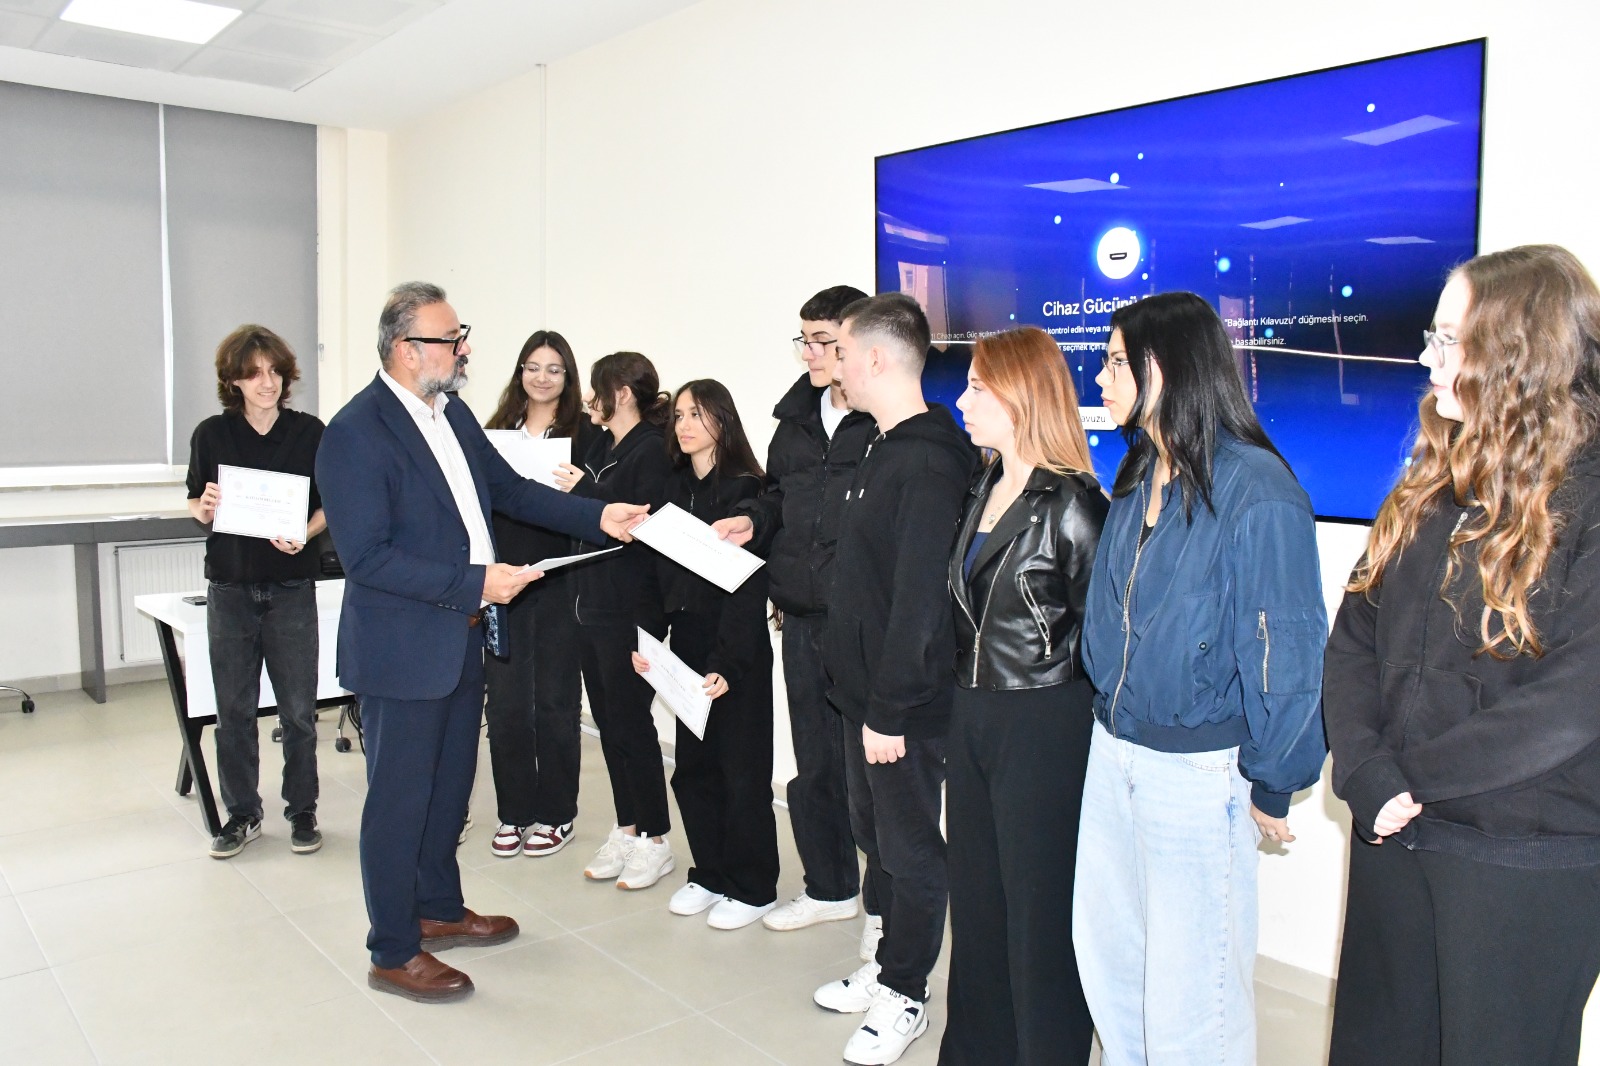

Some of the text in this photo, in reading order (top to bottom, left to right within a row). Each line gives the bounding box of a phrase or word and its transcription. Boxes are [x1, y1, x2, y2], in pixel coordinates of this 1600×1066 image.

[1042, 300, 1080, 317] Cihaz
[966, 330, 978, 339] Güç
[1047, 326, 1070, 335] kontrol
[1070, 325, 1085, 333] edin
[1085, 325, 1101, 335] veya
[1260, 315, 1297, 326] Kılavuzu"
[1298, 314, 1342, 326] düğmesini
[1343, 313, 1369, 325] seçin.
[1235, 336, 1287, 346] basabilirsiniz.
[1081, 415, 1106, 423] avuzu
